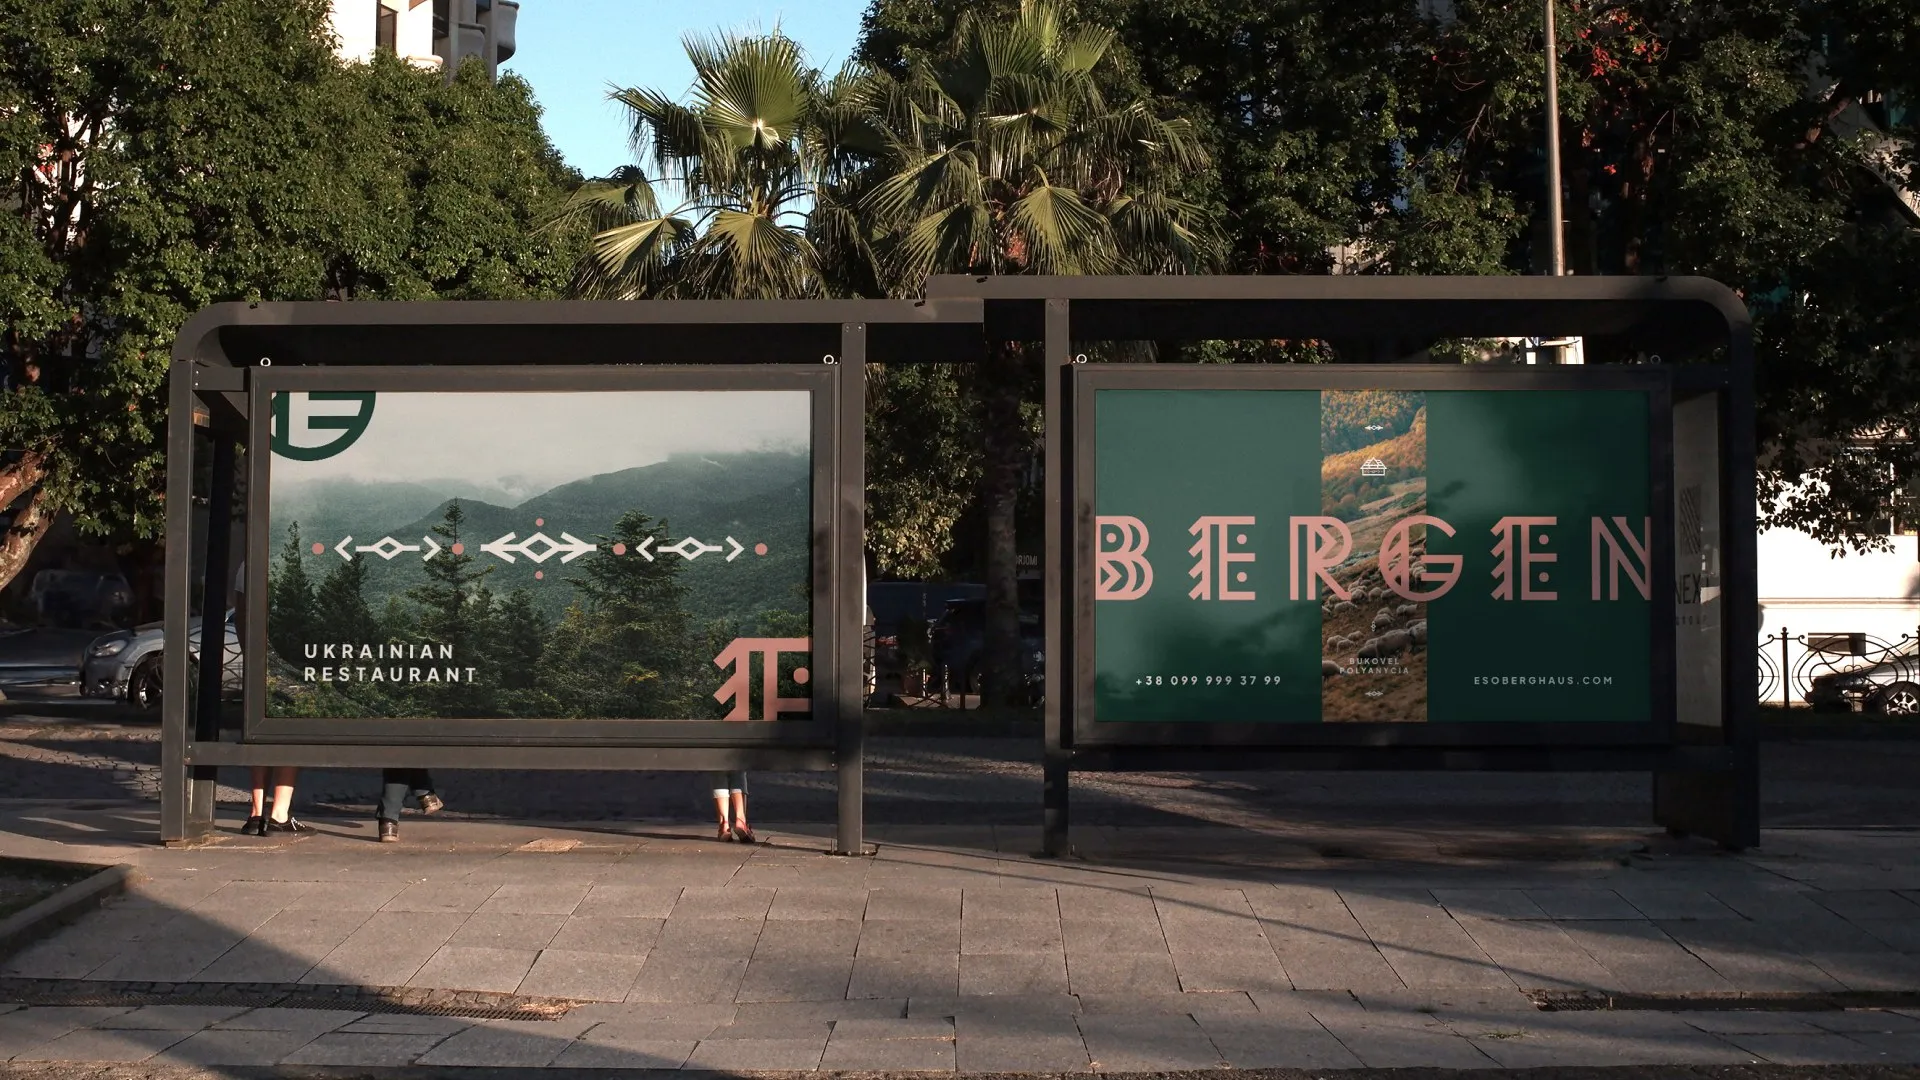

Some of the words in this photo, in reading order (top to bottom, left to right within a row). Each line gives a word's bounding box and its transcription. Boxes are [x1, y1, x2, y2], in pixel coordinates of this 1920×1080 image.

[1095, 515, 1652, 601] BERGEN
[304, 643, 453, 659] UKRAINIAN
[1349, 657, 1400, 665] BUKOVEL
[304, 666, 477, 683] RESTAURANT
[1135, 675, 1163, 686] +38
[1170, 675, 1198, 686] 099
[1205, 675, 1233, 686] 999
[1239, 675, 1257, 686] 37
[1263, 675, 1281, 686] 99
[1473, 676, 1613, 685] ESOBERGHAUS.COM
